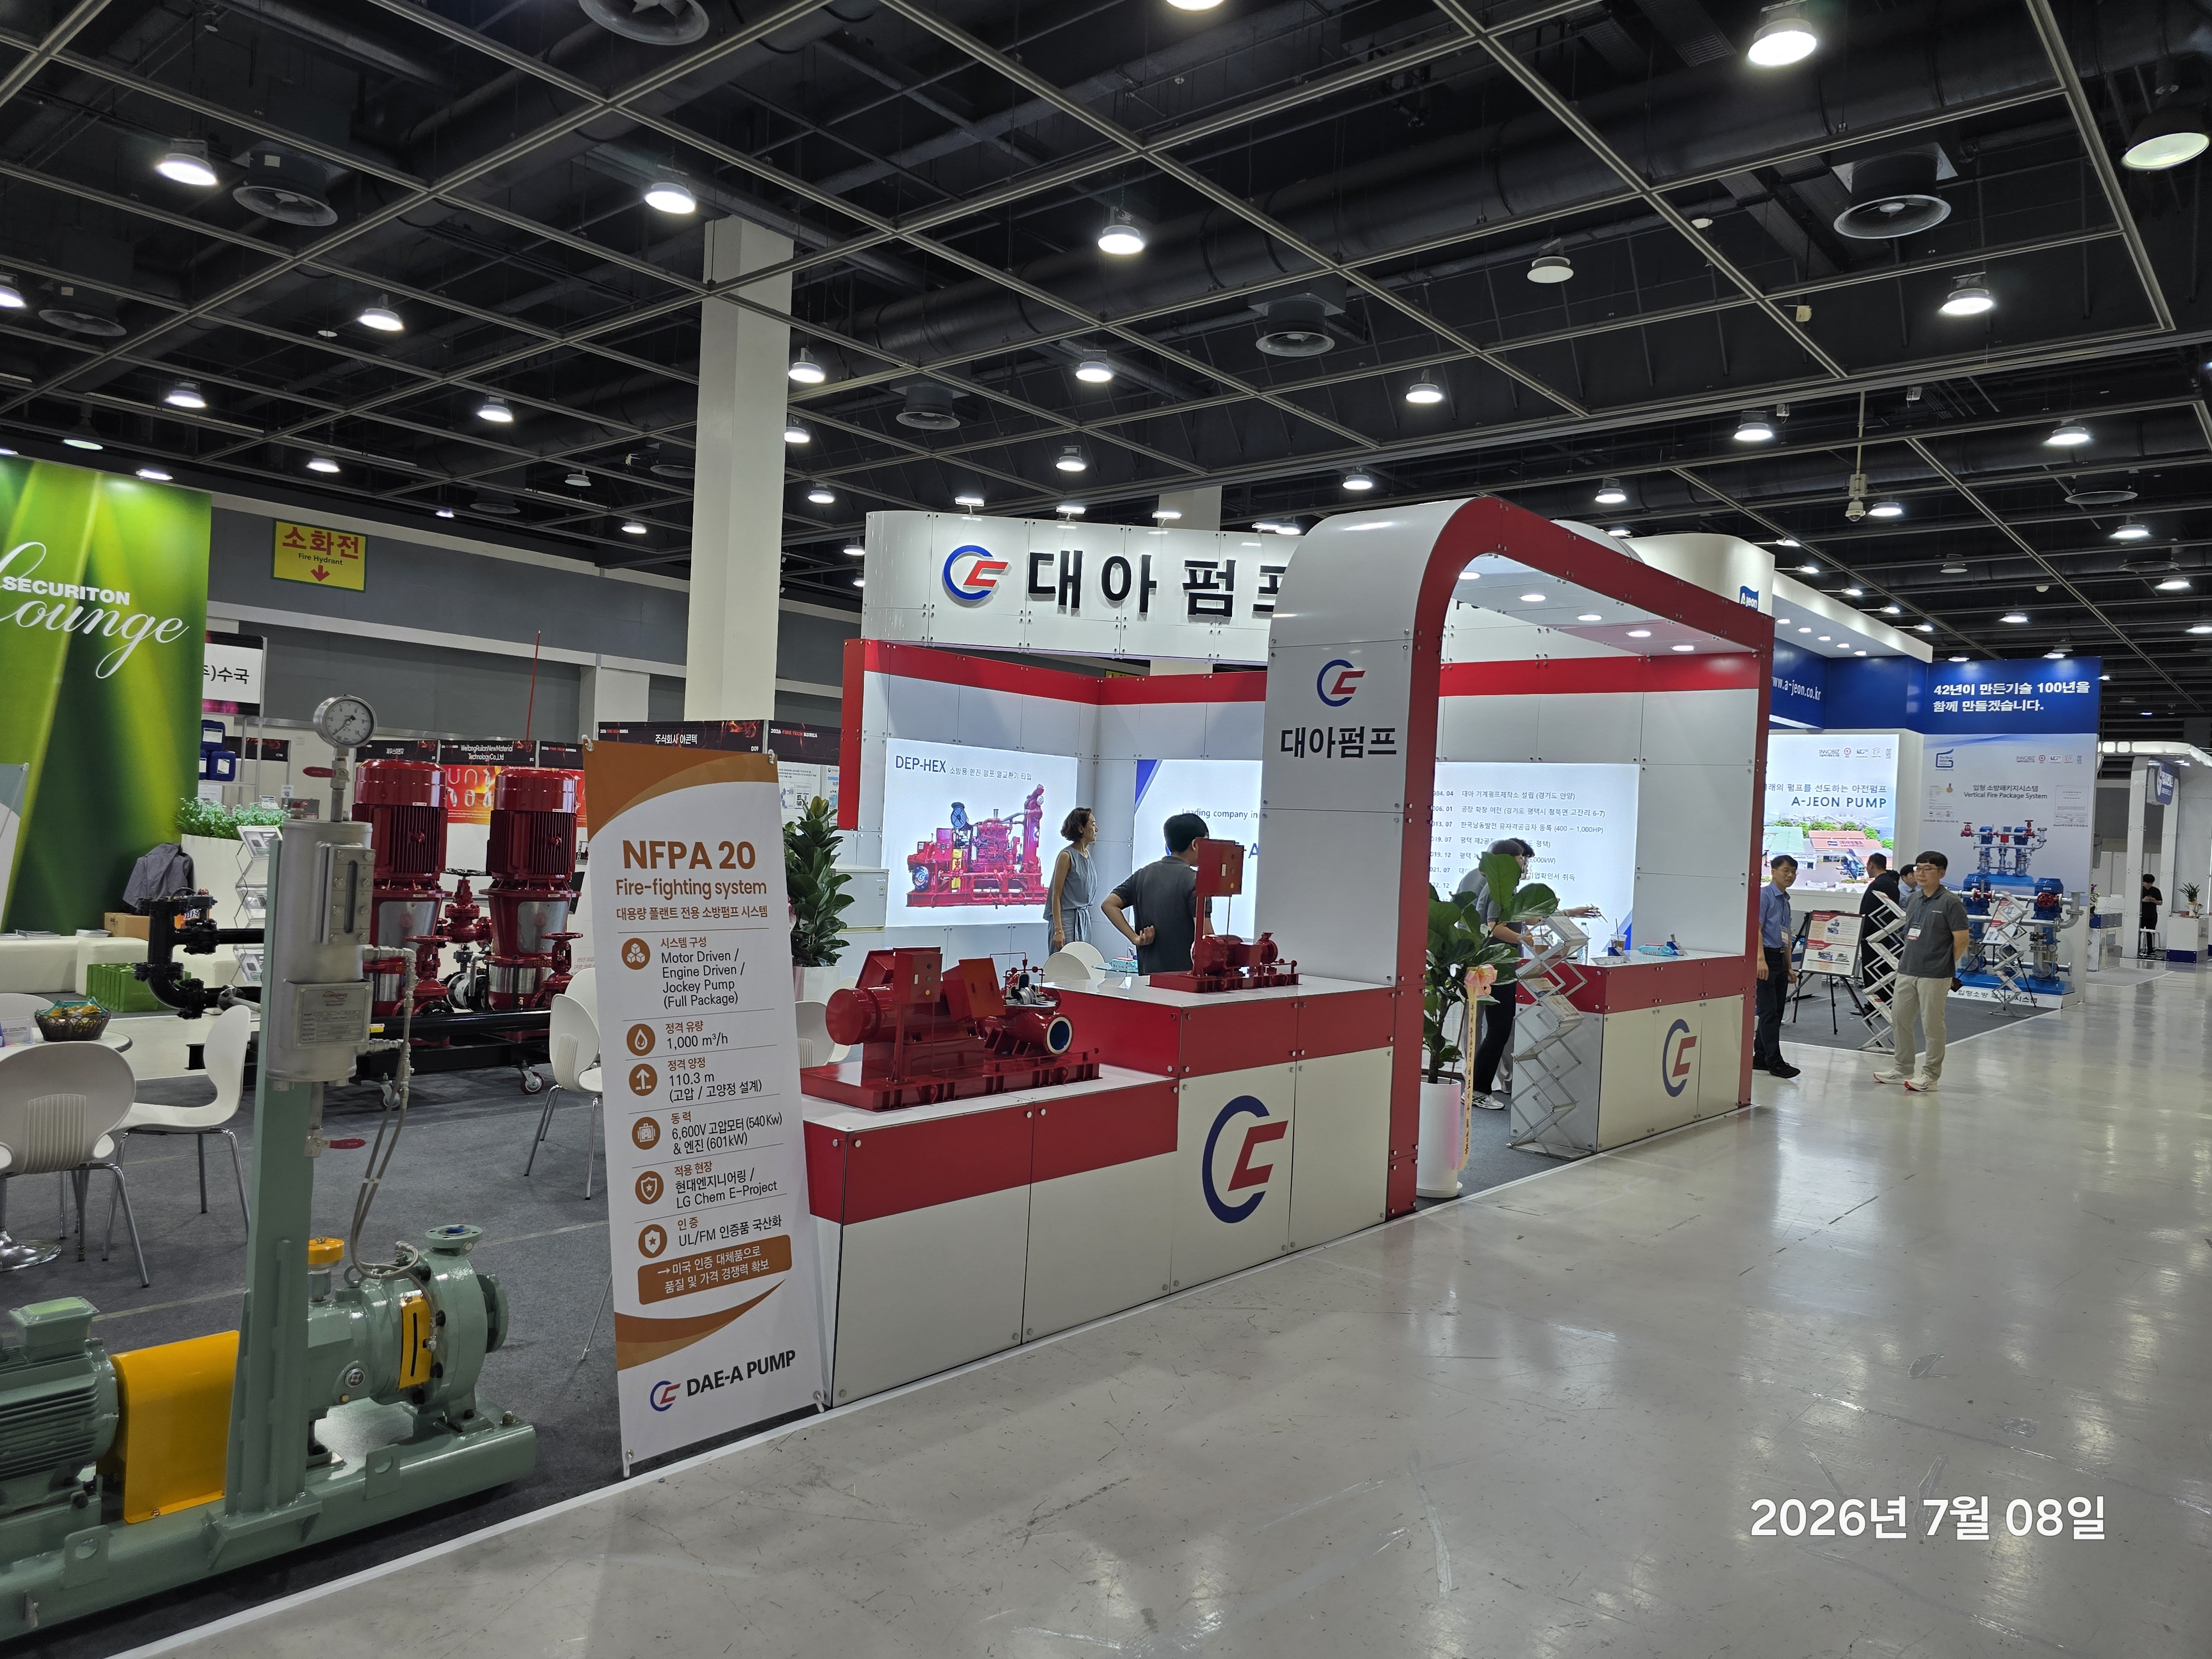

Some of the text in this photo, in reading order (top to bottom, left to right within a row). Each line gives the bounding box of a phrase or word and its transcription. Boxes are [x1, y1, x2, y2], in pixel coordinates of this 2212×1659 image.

[282, 526, 360, 559] 소화전
[298, 552, 343, 566] Fire Hydrant
[3, 576, 129, 605] SECURITON
[1772, 676, 1821, 700] ww.a-jeon.co.kr
[1933, 681, 2090, 696] 42년이 만든기술 100년을
[1933, 699, 2044, 712] 함께 만들겠습니다.
[655, 734, 679, 744] 주식회사
[1281, 727, 1397, 758] 대아펌프
[896, 755, 946, 773] DEP-HEX
[950, 767, 967, 775] 소방용
[984, 769, 994, 778] 펌프
[1852, 785, 1887, 793] 아전펌프
[1791, 796, 1887, 808] A-JEON PUMP
[1213, 811, 1248, 820] company
[623, 840, 755, 869] NFPA 20
[615, 878, 767, 900] Fire-fighting system
[617, 905, 768, 920] 대용량 플랜트 전용 소방펌프 시스템
[661, 937, 707, 948] 시스템 구성
[661, 948, 739, 963] Motor Driven /
[662, 962, 745, 980] Engine Driven /
[663, 979, 734, 993] Jockey Pump
[664, 991, 738, 1009] (Full Package)
[665, 1020, 703, 1034] 정격 유량
[667, 1035, 698, 1050] 1,000
[667, 1057, 706, 1071] 정격 양정
[669, 1072, 714, 1086] 110.3 m
[670, 1079, 761, 1103] (고압 / 고양정 설계)
[672, 1124, 706, 1140] 6,600V
[709, 1118, 744, 1134] 고압모터
[674, 1131, 747, 1155] & 엔진 (601kW)
[674, 1161, 712, 1177] 적용 현장
[676, 1167, 754, 1194] 현대엔지니어링 /
[677, 1181, 777, 1208] LG Chem E-Project
[679, 1215, 782, 1246] UL/FM 인증품 국산화
[672, 1246, 761, 1275] 미국 인증 대체품으로
[665, 1259, 769, 1293] 품질 및 가격 경쟁력 확보
[687, 1350, 796, 1396] DAE-A PUMP
